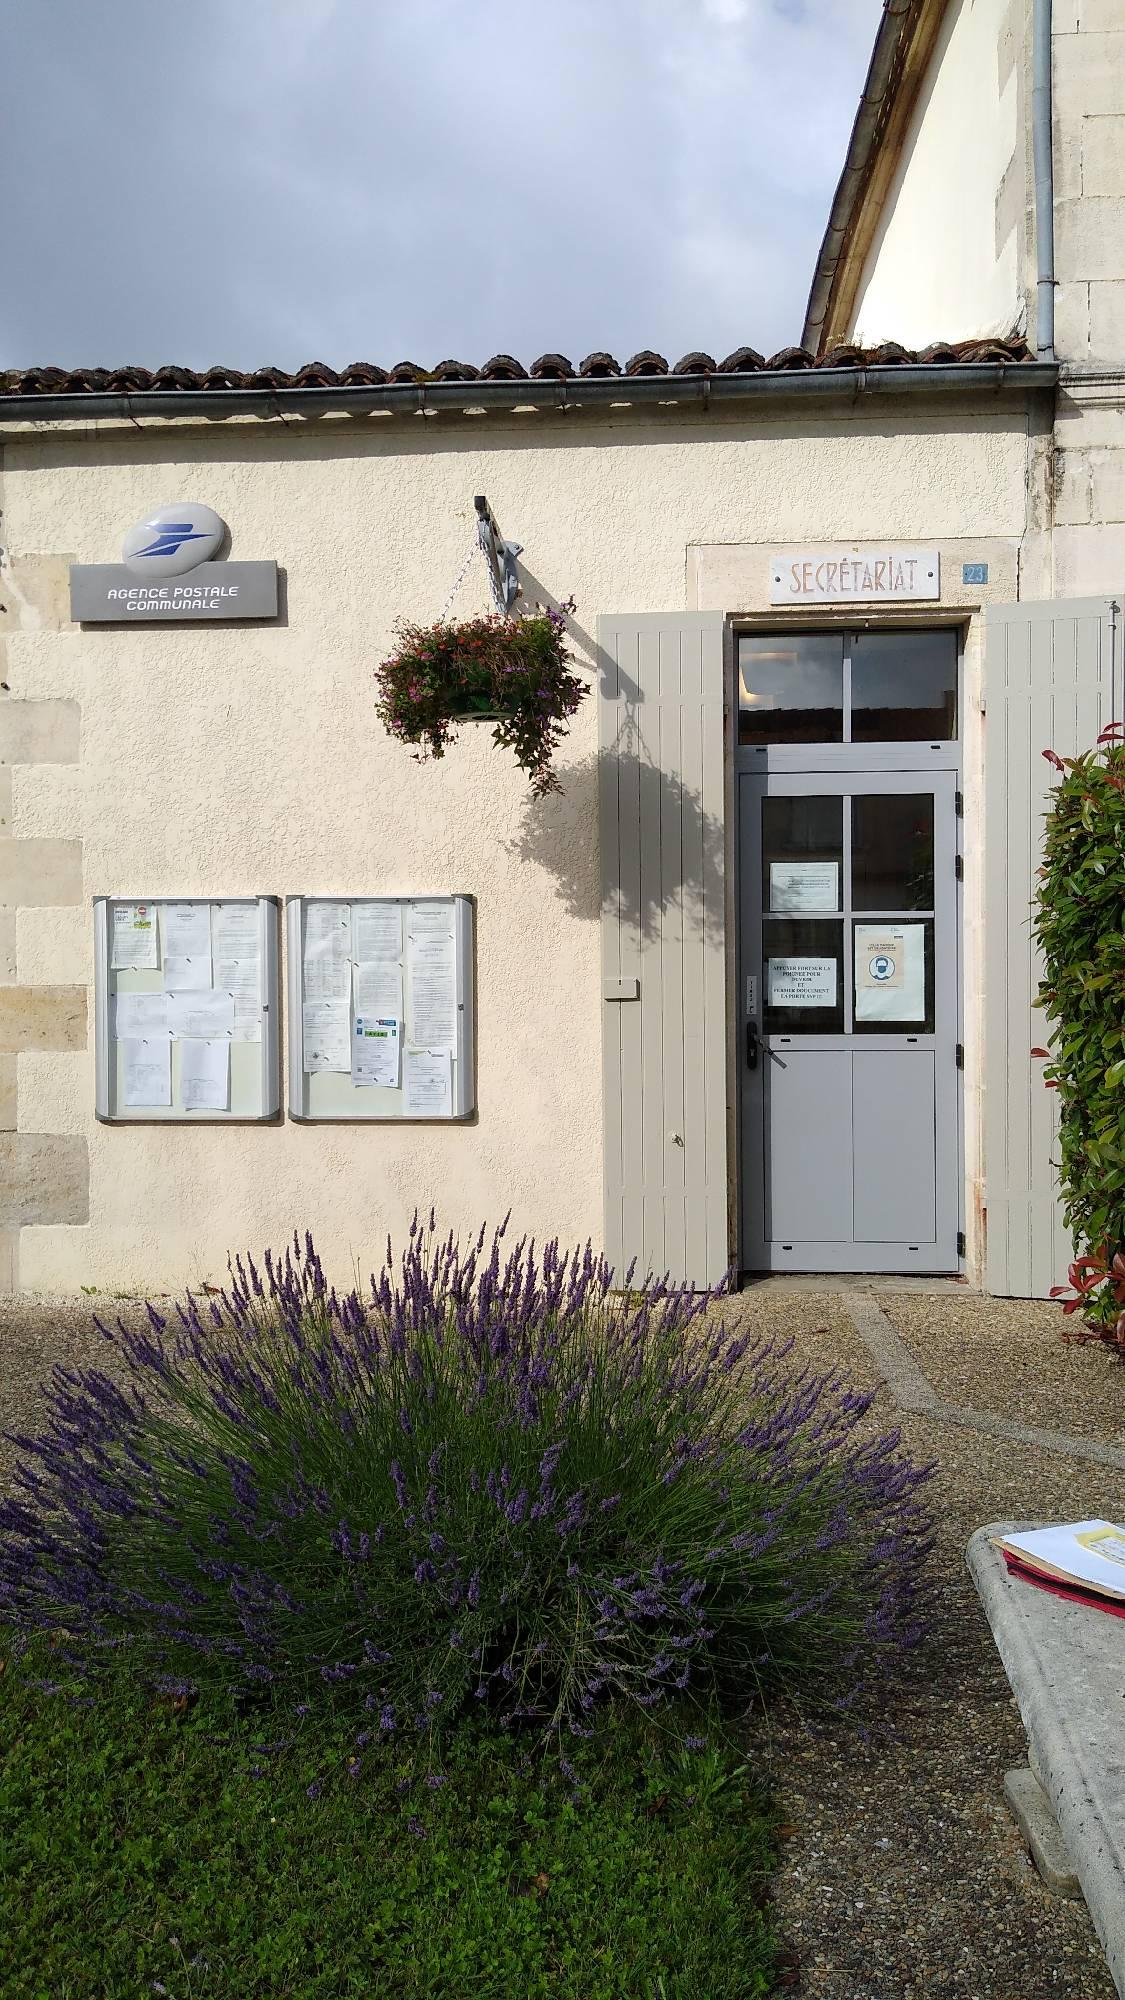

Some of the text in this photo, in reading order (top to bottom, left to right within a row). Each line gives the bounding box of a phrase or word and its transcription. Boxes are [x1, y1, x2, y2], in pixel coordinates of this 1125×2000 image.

[789, 556, 918, 594] SECRÉTARIAT
[966, 565, 984, 582] 23
[107, 586, 240, 599] AGENCE POSTALE
[126, 599, 221, 611] COMMUNALE
